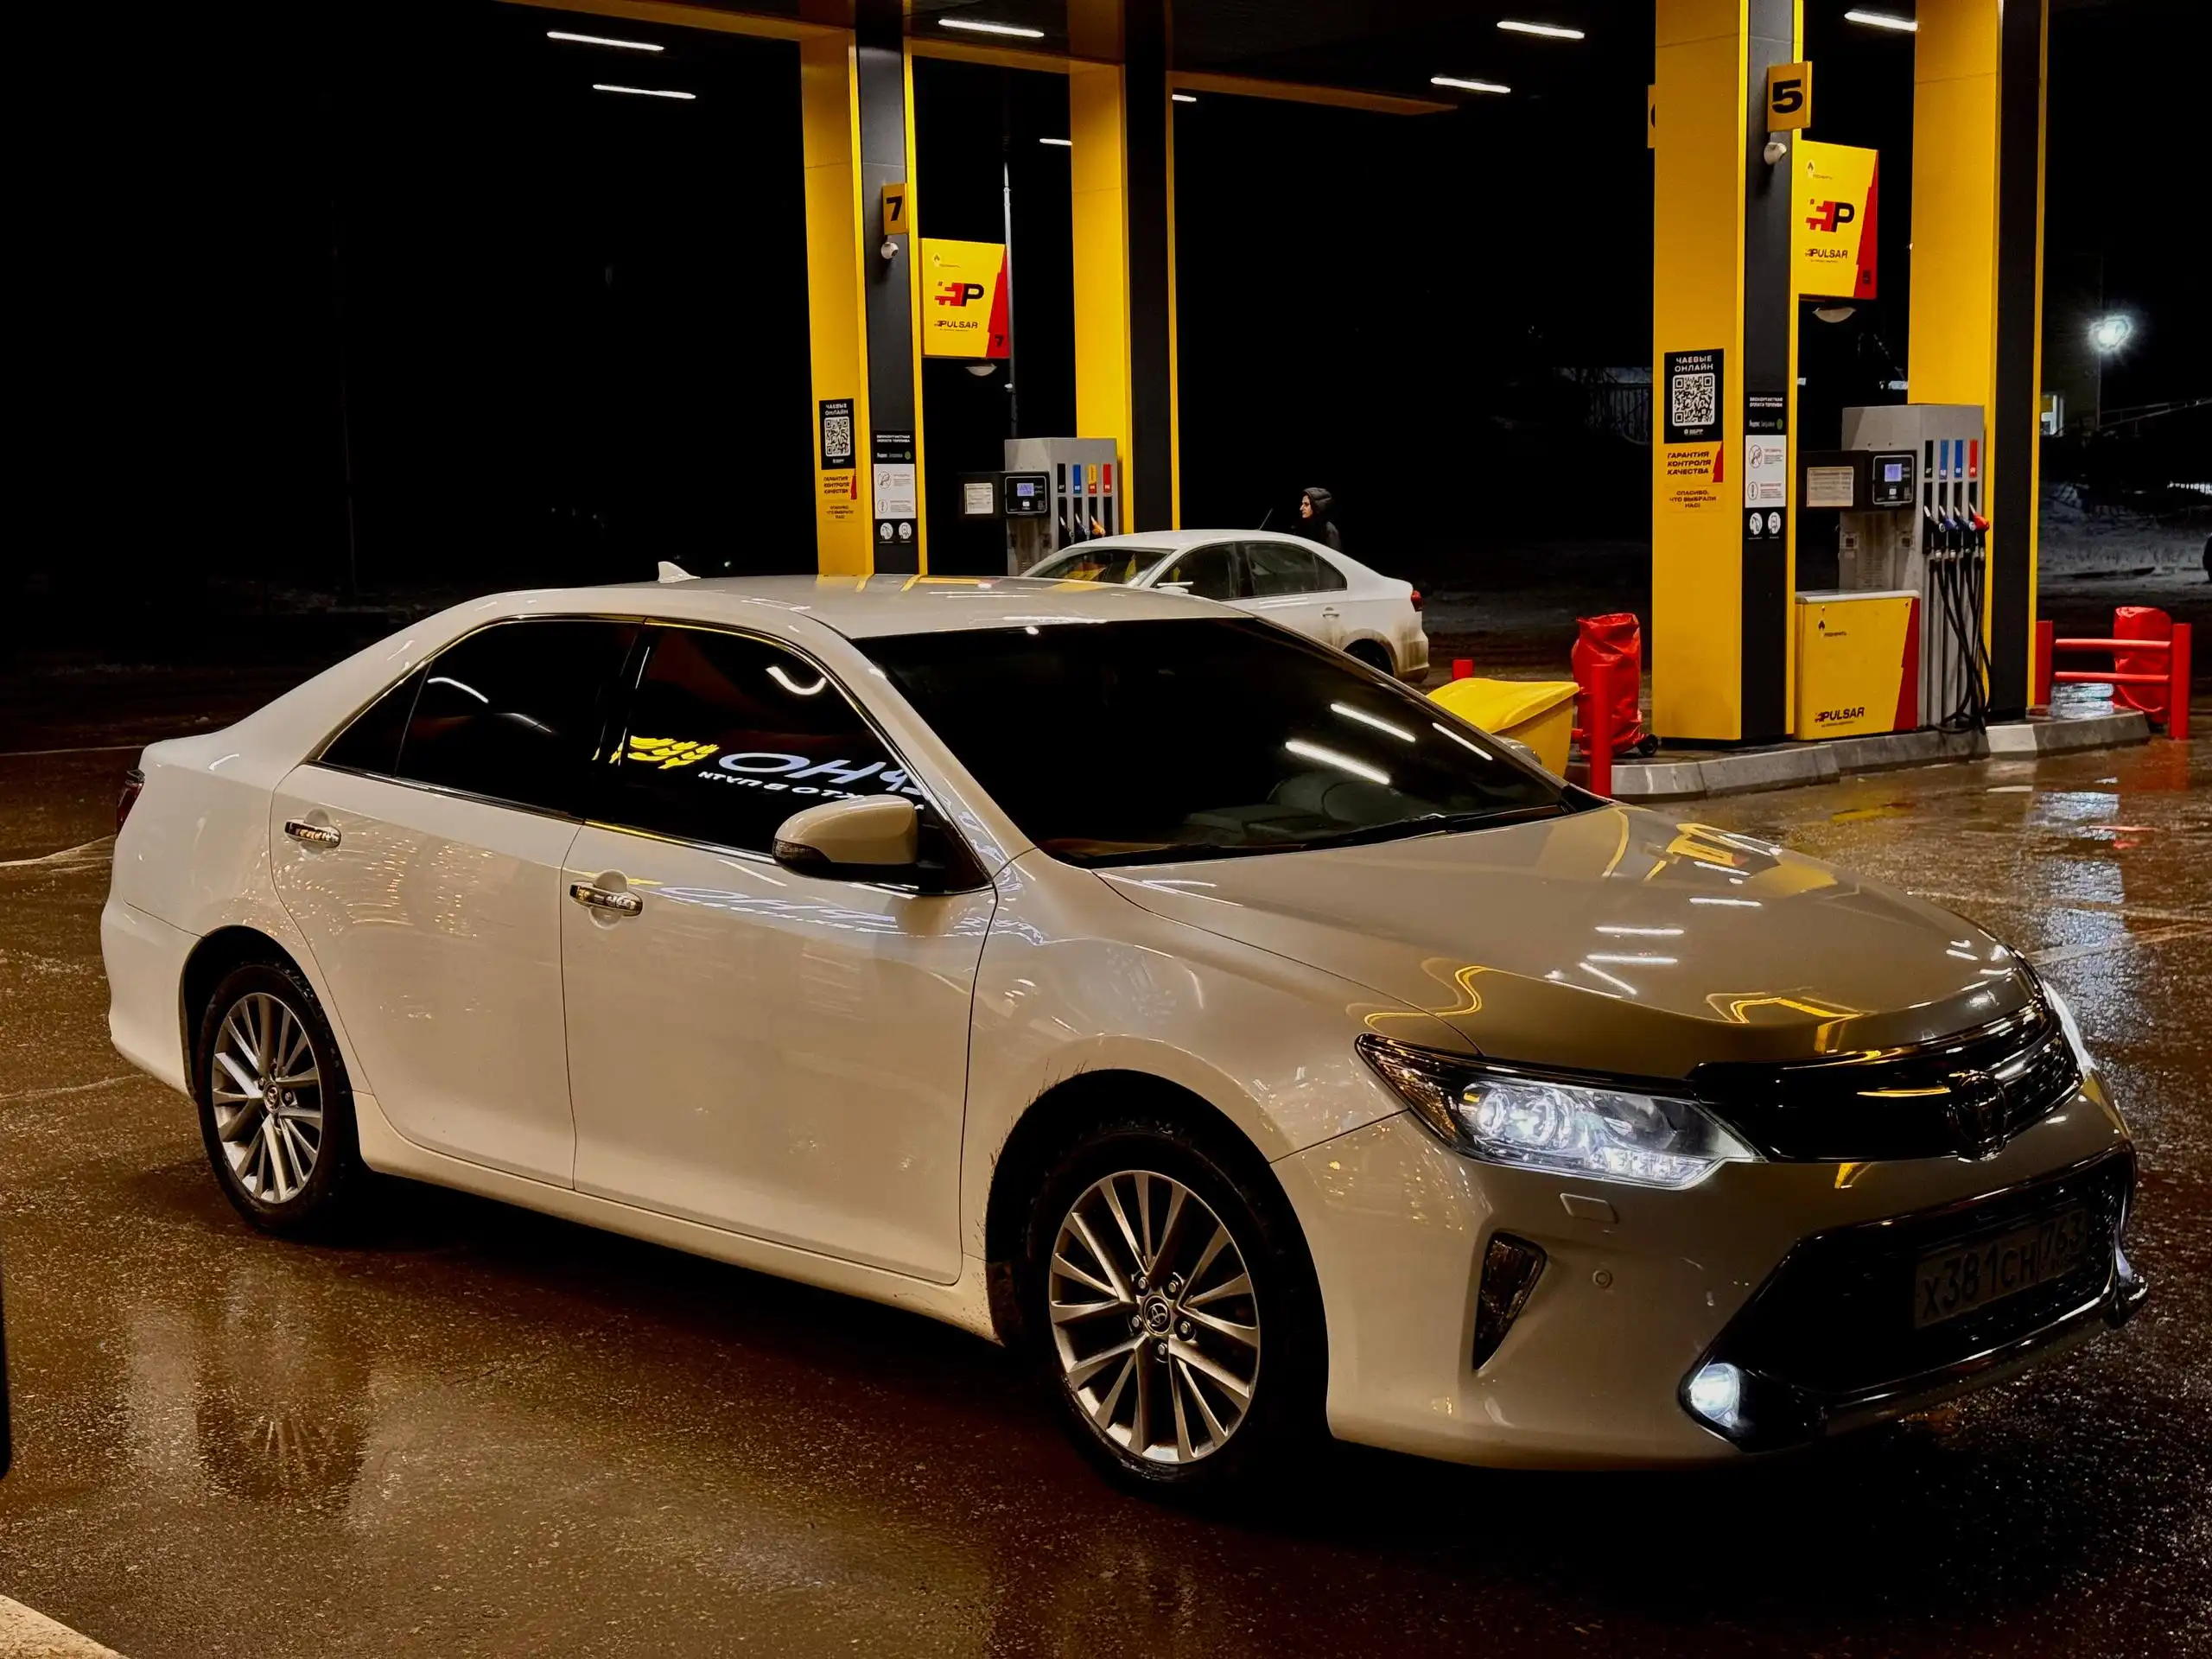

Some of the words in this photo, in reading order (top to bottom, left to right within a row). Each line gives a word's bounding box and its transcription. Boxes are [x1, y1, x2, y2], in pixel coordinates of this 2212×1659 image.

[1772, 79, 1803, 114] 5
[886, 195, 903, 222] 7
[1810, 248, 1848, 259] PULSAR
[939, 320, 979, 329] PULSAR
[995, 334, 1005, 348] 7
[1675, 355, 1713, 364] ЧАЕВЫЕ
[1675, 364, 1714, 372] ОНЛАЙН
[1667, 451, 1710, 460] ГАРАНТИЯ
[1821, 707, 1865, 722] PULSAR
